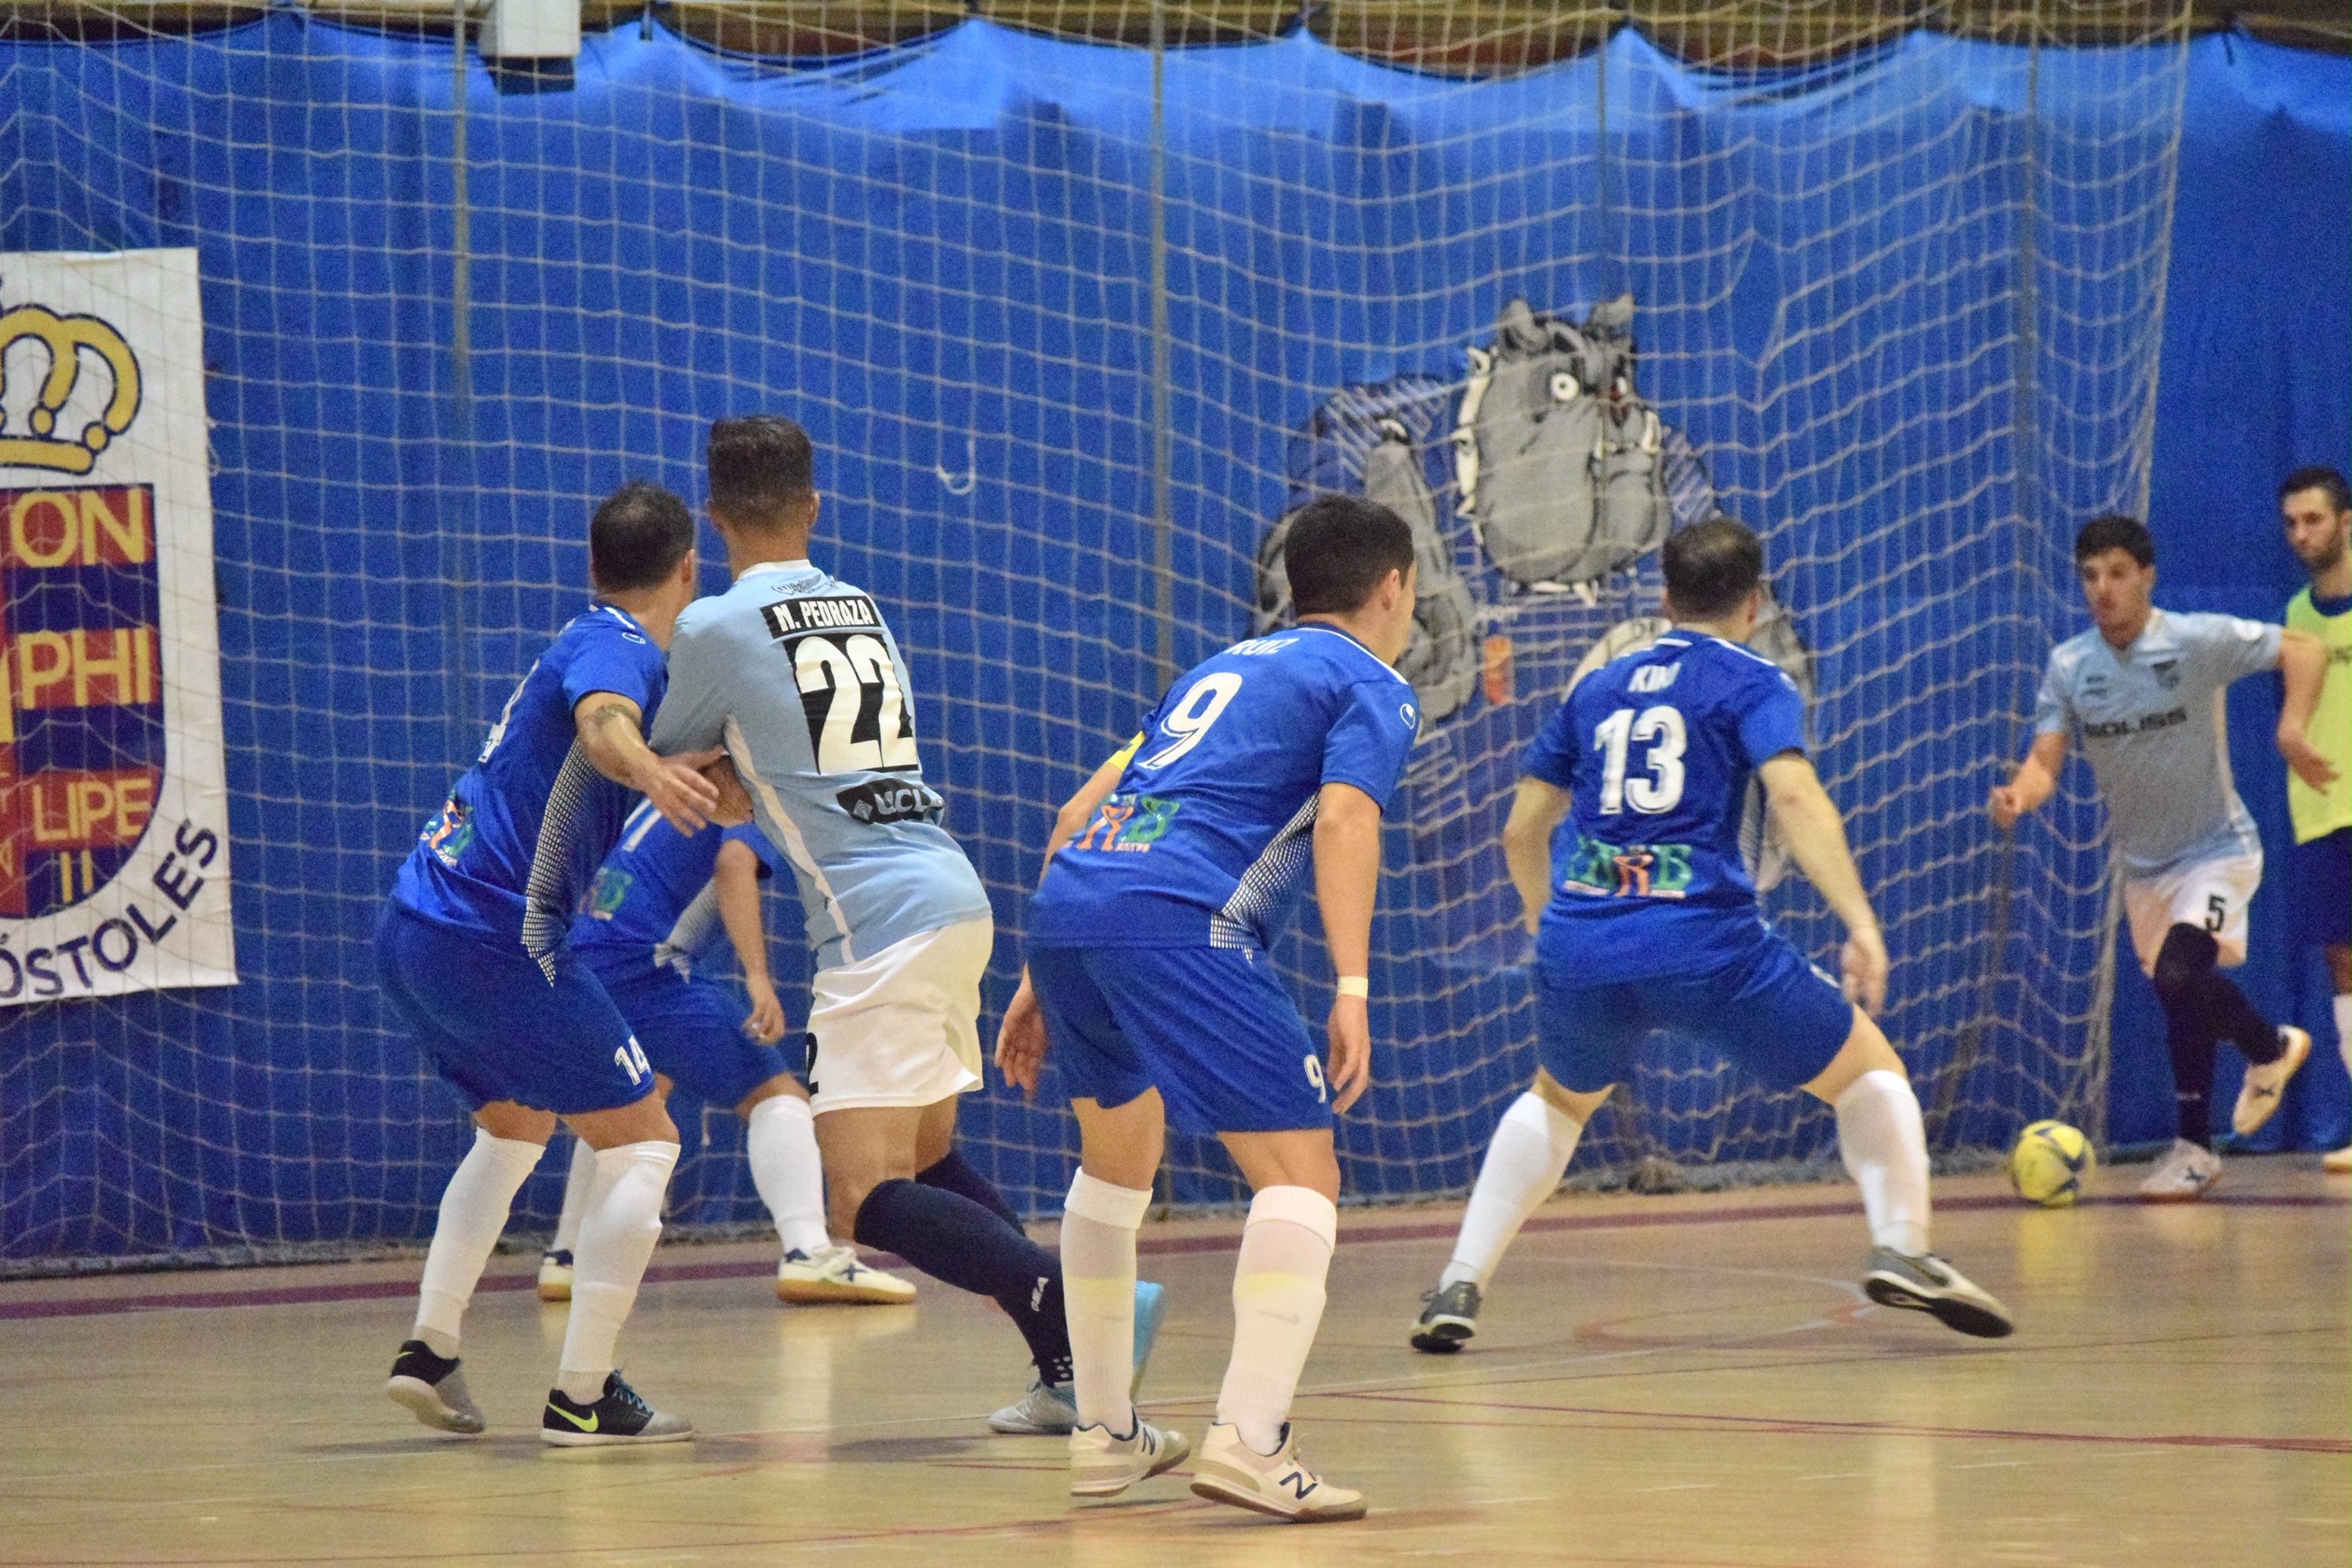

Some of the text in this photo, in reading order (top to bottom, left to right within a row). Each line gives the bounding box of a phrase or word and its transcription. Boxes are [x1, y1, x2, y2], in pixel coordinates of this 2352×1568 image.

[772, 599, 875, 632] N. PEDRAZA
[18, 627, 153, 710] PHI
[1223, 638, 1300, 655] RUIZ
[794, 633, 918, 776] 22
[1137, 672, 1242, 770] 9
[1593, 706, 1688, 815] 13
[32, 778, 153, 842] LIPE
[2205, 895, 2225, 932] 5
[614, 1035, 652, 1086] 14
[1304, 1054, 1327, 1103] 9
